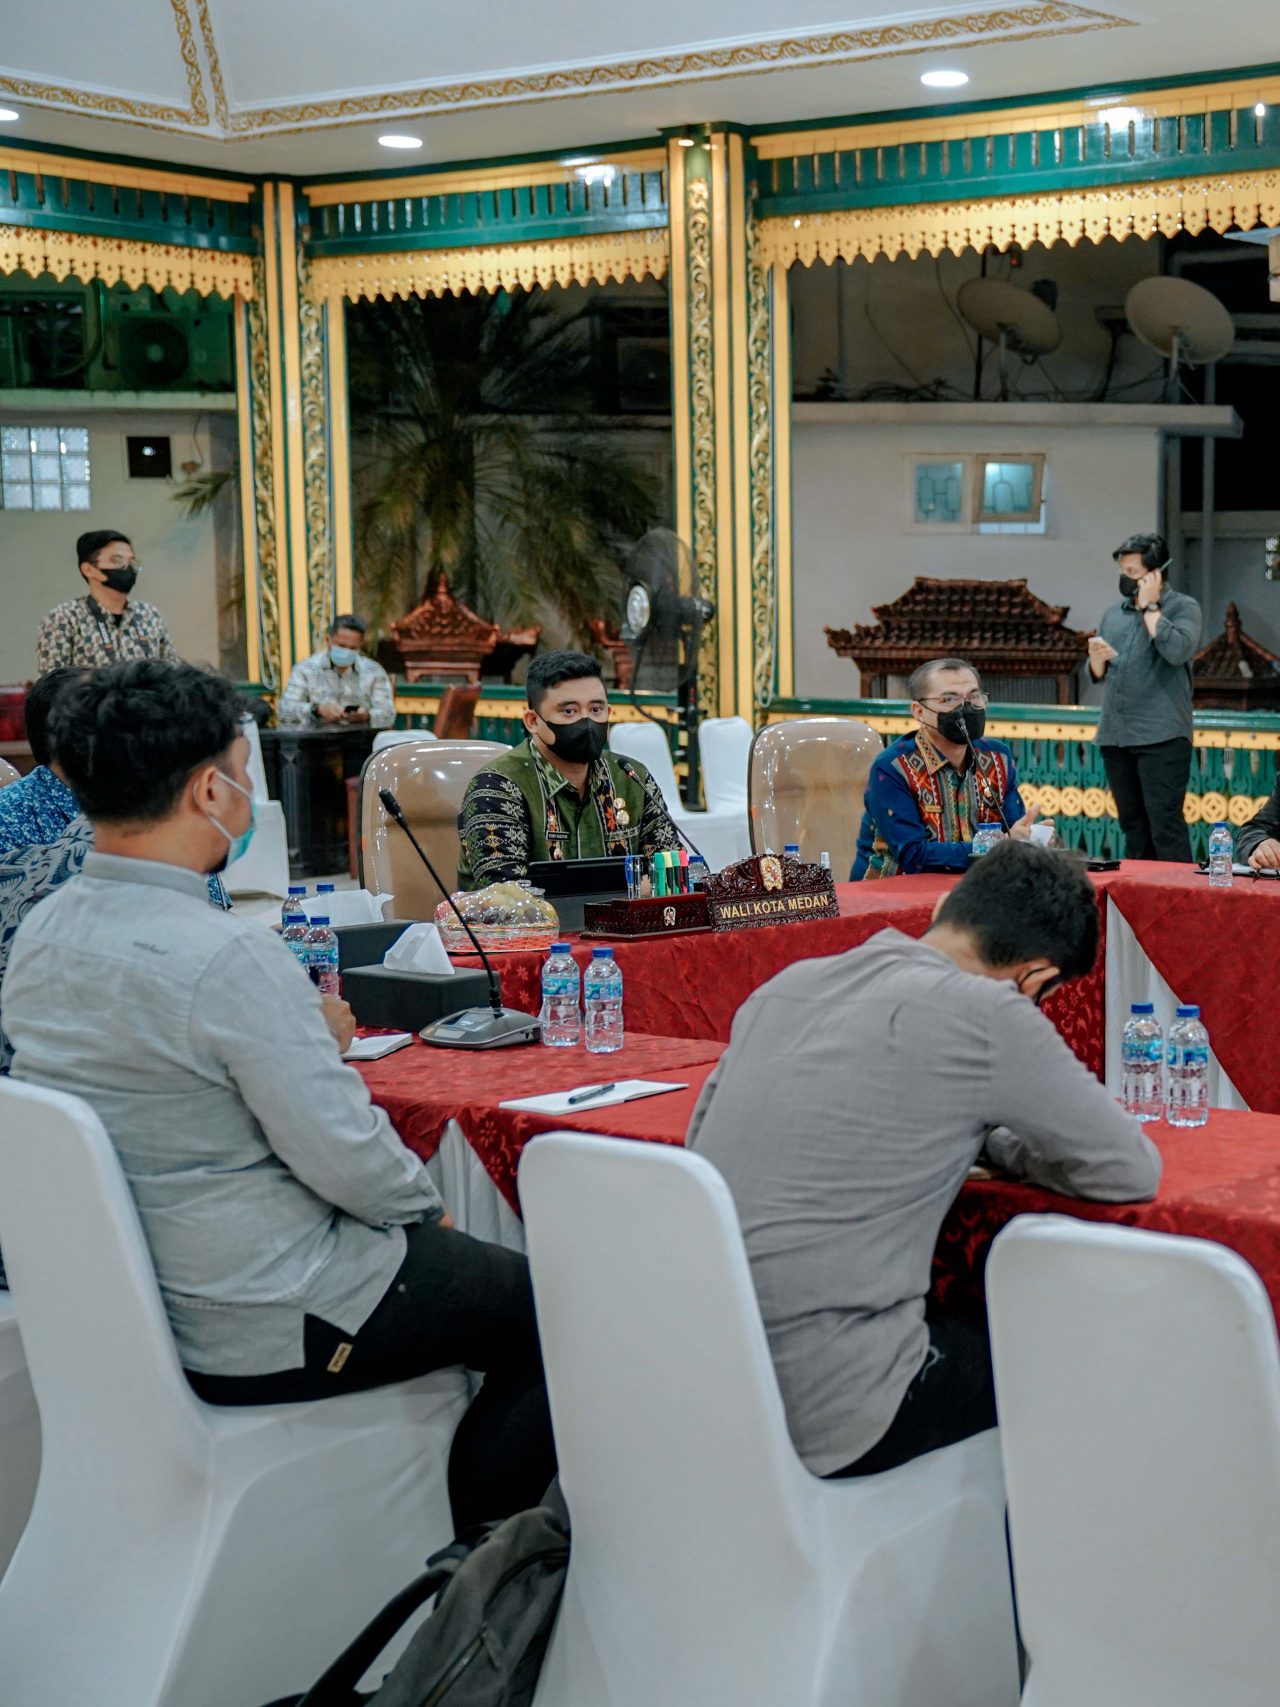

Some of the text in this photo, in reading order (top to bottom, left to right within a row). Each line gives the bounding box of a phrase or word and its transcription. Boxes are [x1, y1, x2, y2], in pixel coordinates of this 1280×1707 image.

[720, 895, 829, 919] WALI KOTA MEDAN
